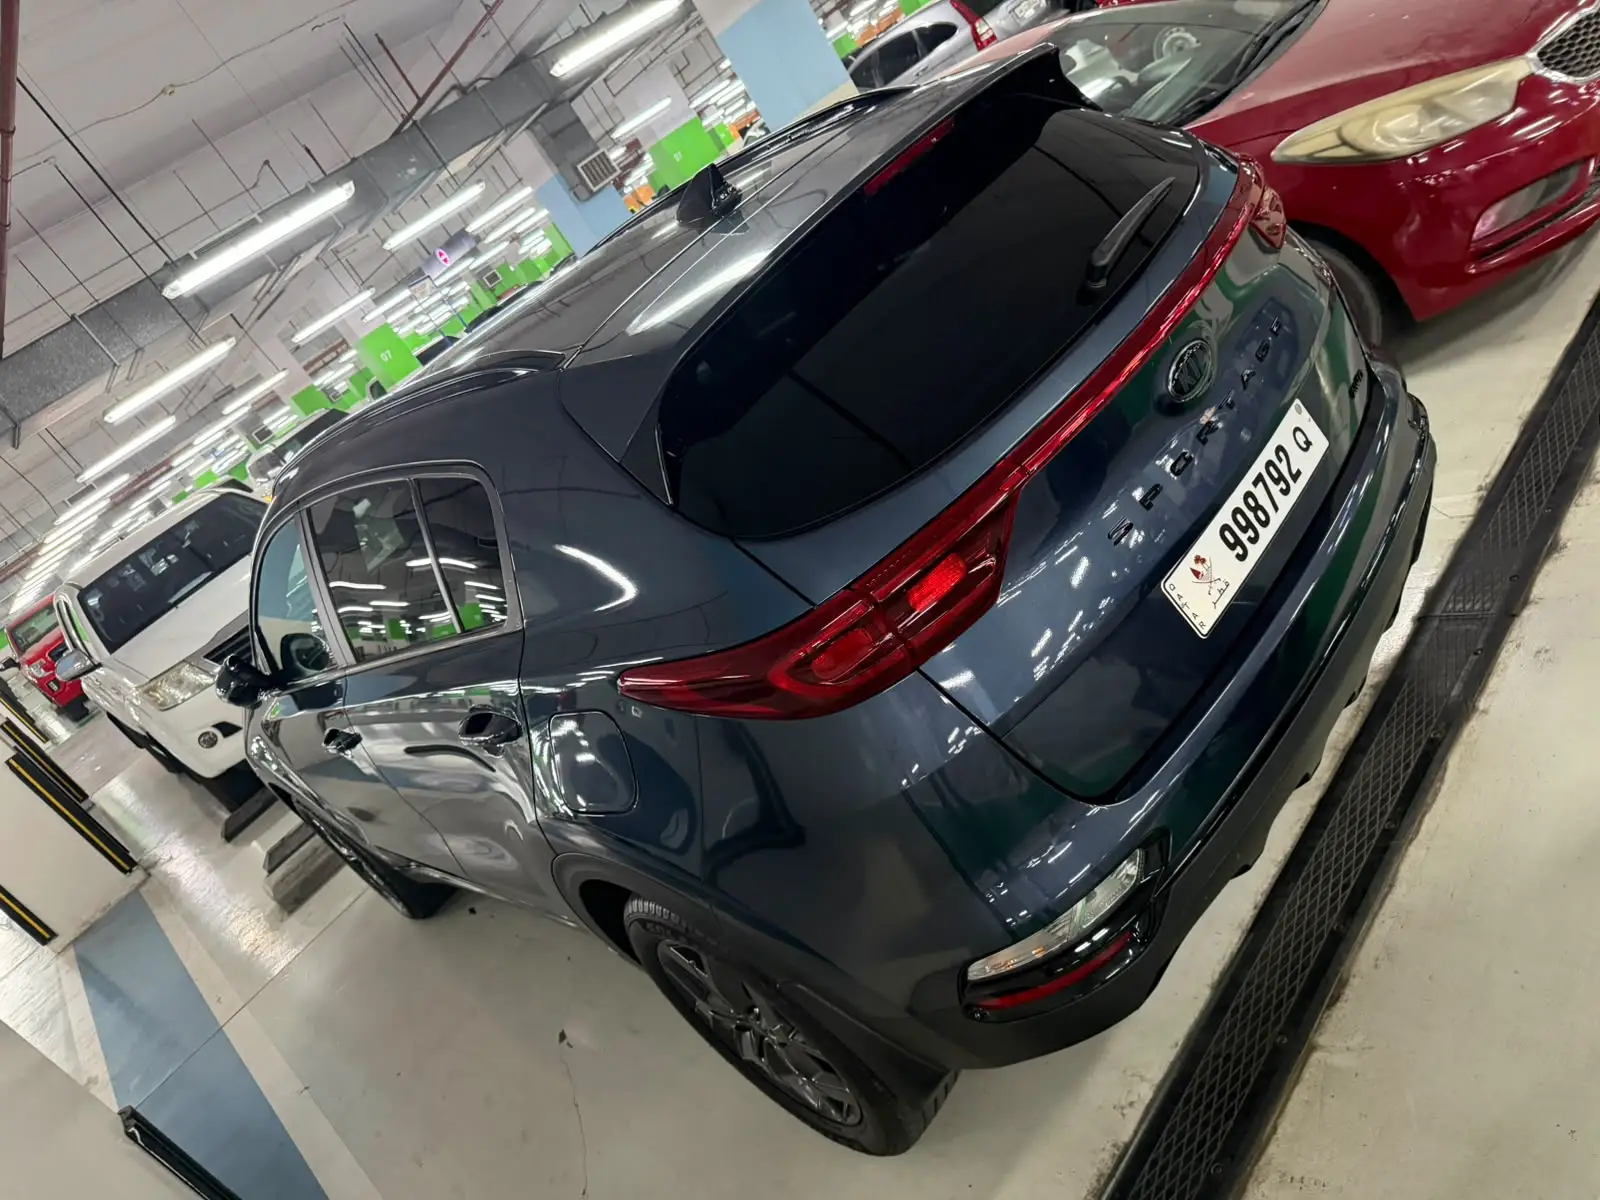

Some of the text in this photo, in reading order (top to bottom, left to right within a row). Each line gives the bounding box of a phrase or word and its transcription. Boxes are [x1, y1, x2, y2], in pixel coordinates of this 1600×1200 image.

[1107, 316, 1282, 546] SPORTAGE
[1218, 426, 1314, 562] 998792 Q
[1168, 583, 1207, 630] QATAR
[1212, 578, 1230, 610] قطر
